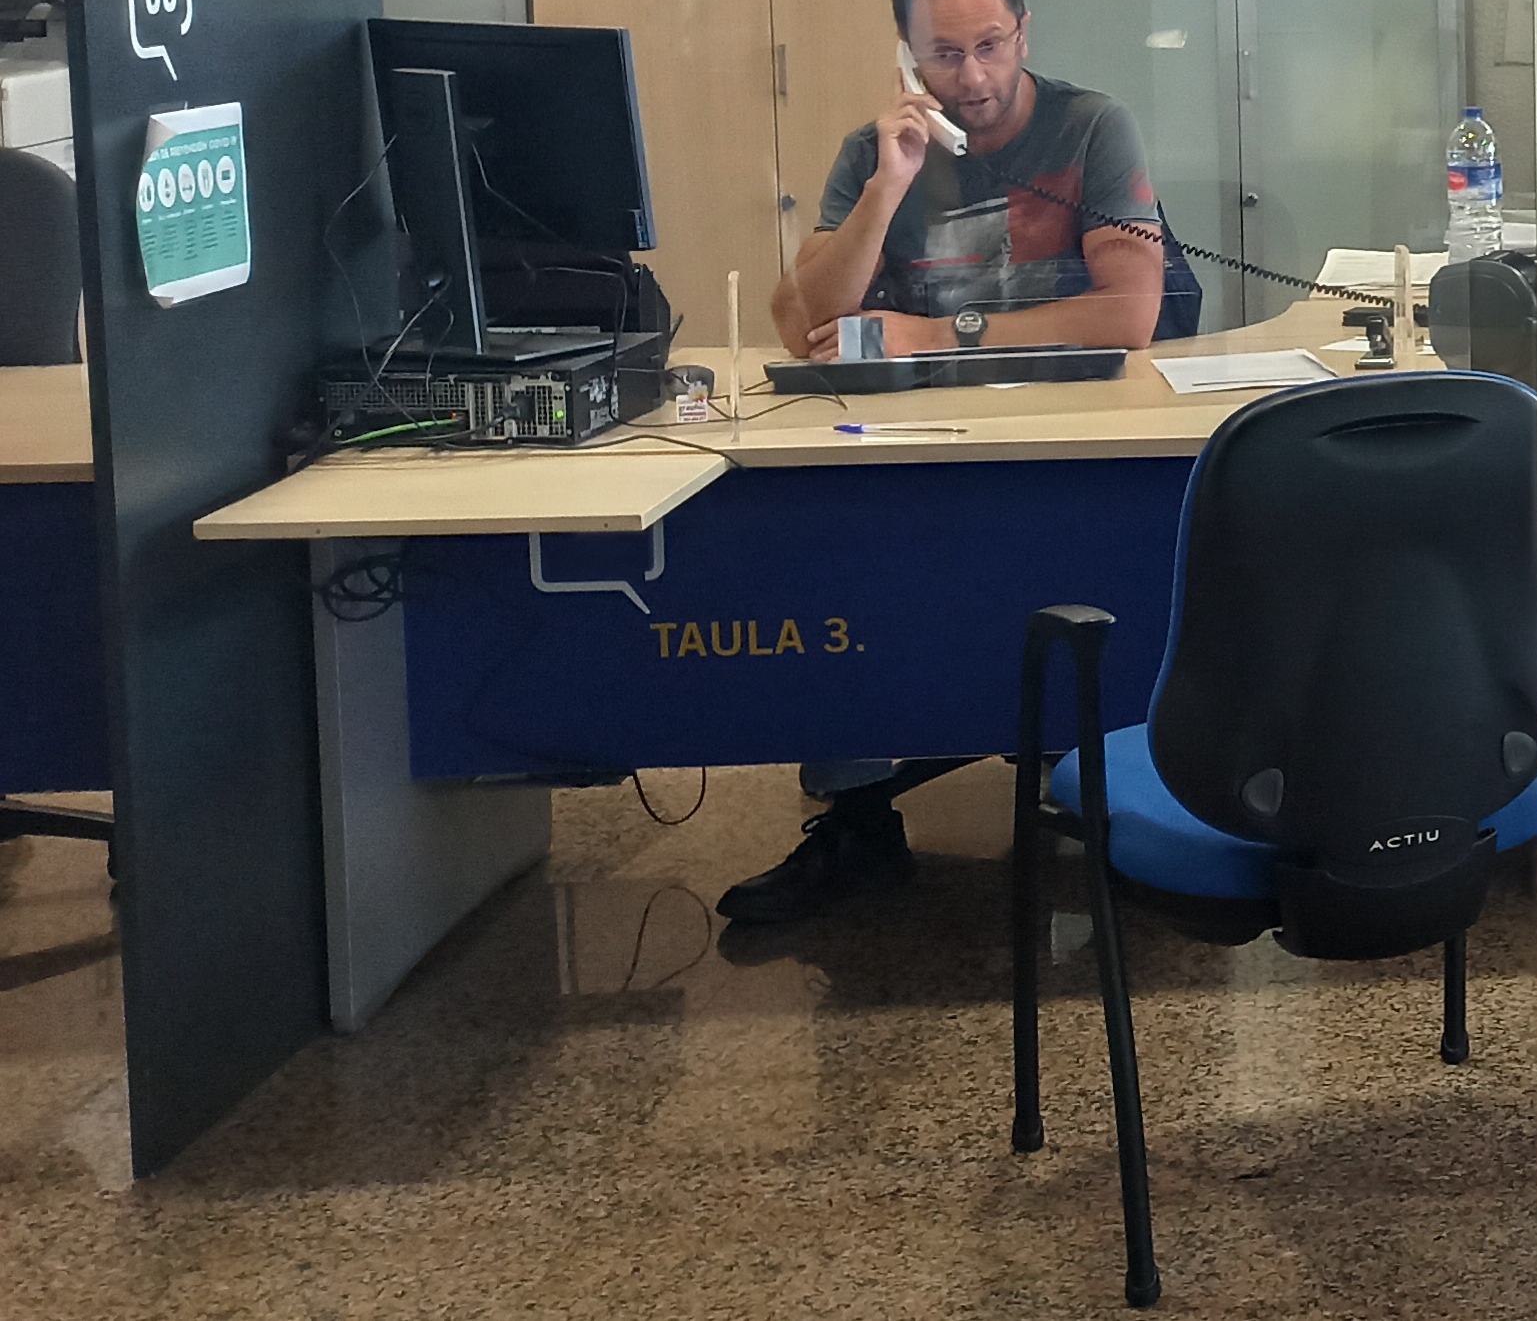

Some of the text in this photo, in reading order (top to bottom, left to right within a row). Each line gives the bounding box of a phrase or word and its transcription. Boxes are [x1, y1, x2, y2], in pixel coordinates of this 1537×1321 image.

[650, 618, 864, 657] TAULA 3.
[1370, 830, 1438, 851] ACTIU
